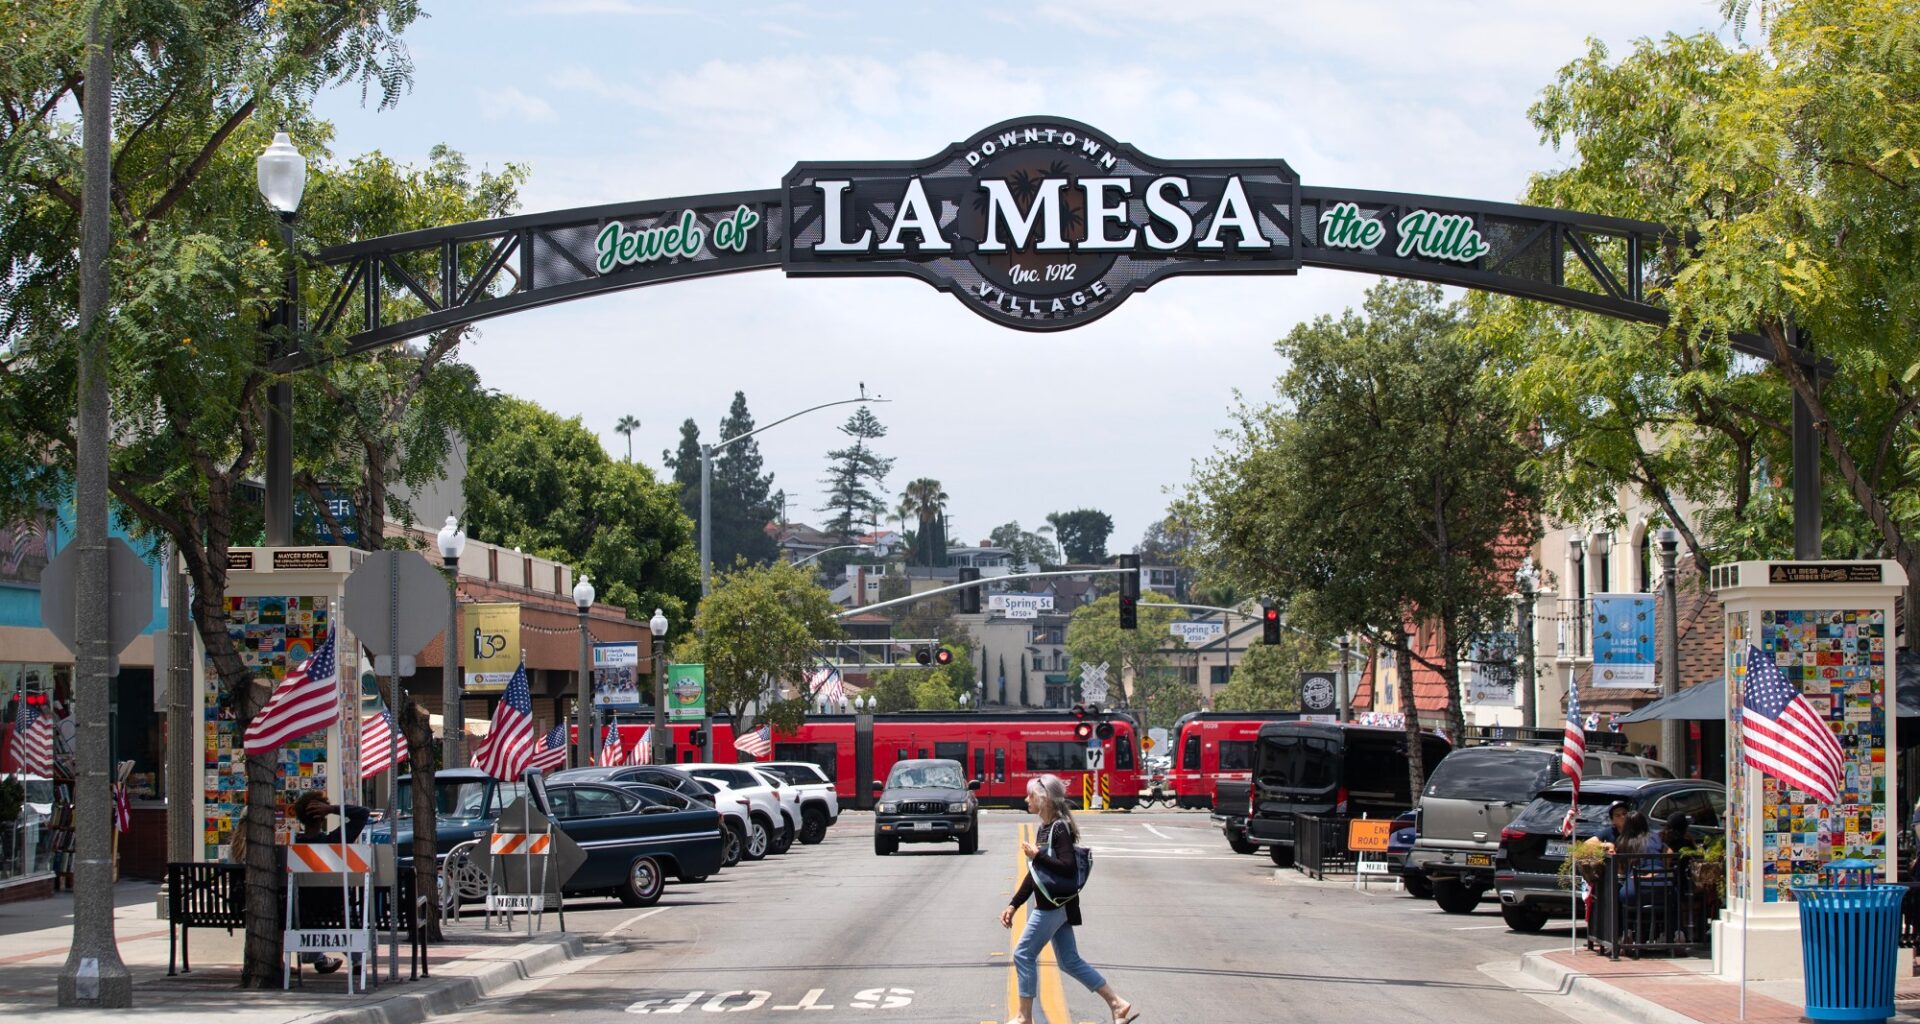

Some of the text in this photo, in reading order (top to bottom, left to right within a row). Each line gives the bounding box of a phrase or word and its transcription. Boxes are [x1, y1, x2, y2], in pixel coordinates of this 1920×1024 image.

[966, 128, 1117, 169] DOWNTOWN
[814, 175, 1270, 251] LA MESA
[596, 205, 759, 274] Jewel of
[1319, 203, 1490, 261] the Hills
[1009, 264, 1077, 284] Inc. 1912
[978, 280, 1107, 312] VILLAGE
[1005, 598, 1051, 610] Spring St
[1183, 625, 1220, 636] Spring St
[1374, 826, 1389, 834] END
[1358, 837, 1378, 845] ROAD
[496, 897, 534, 909] MERAM
[300, 933, 353, 948] MERAM
[624, 987, 915, 1013] STOP
